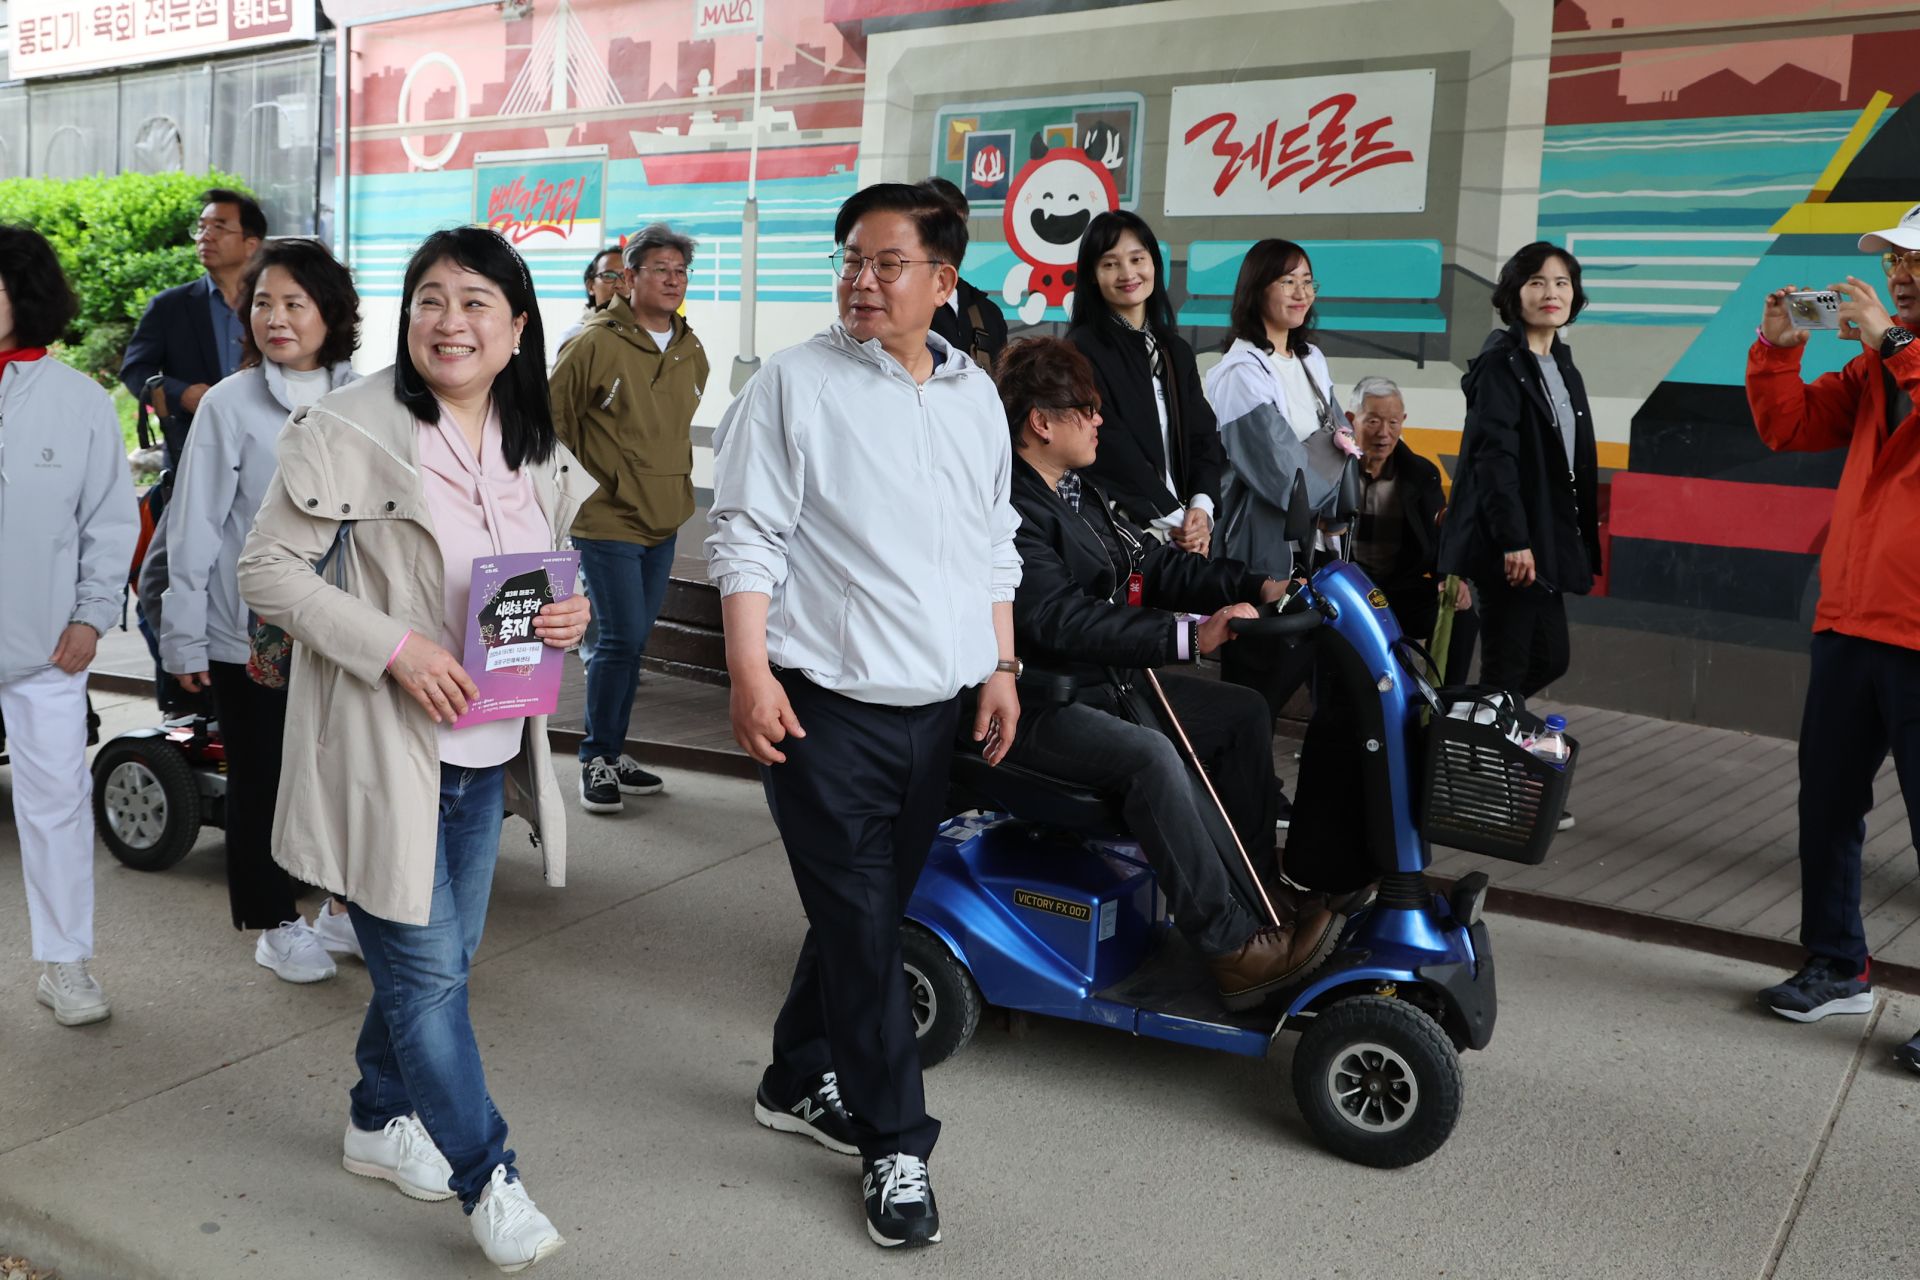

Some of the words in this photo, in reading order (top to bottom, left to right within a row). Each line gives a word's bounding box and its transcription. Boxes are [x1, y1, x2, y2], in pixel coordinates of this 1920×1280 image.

[1184, 93, 1414, 197] 레드로드
[495, 600, 522, 618] 사랑을
[523, 598, 542, 615] 보라
[499, 616, 531, 644] 축제
[1018, 893, 1055, 910] VICTORY
[1056, 902, 1068, 914] FX
[1069, 905, 1087, 918] 007
[791, 1097, 825, 1123] N
